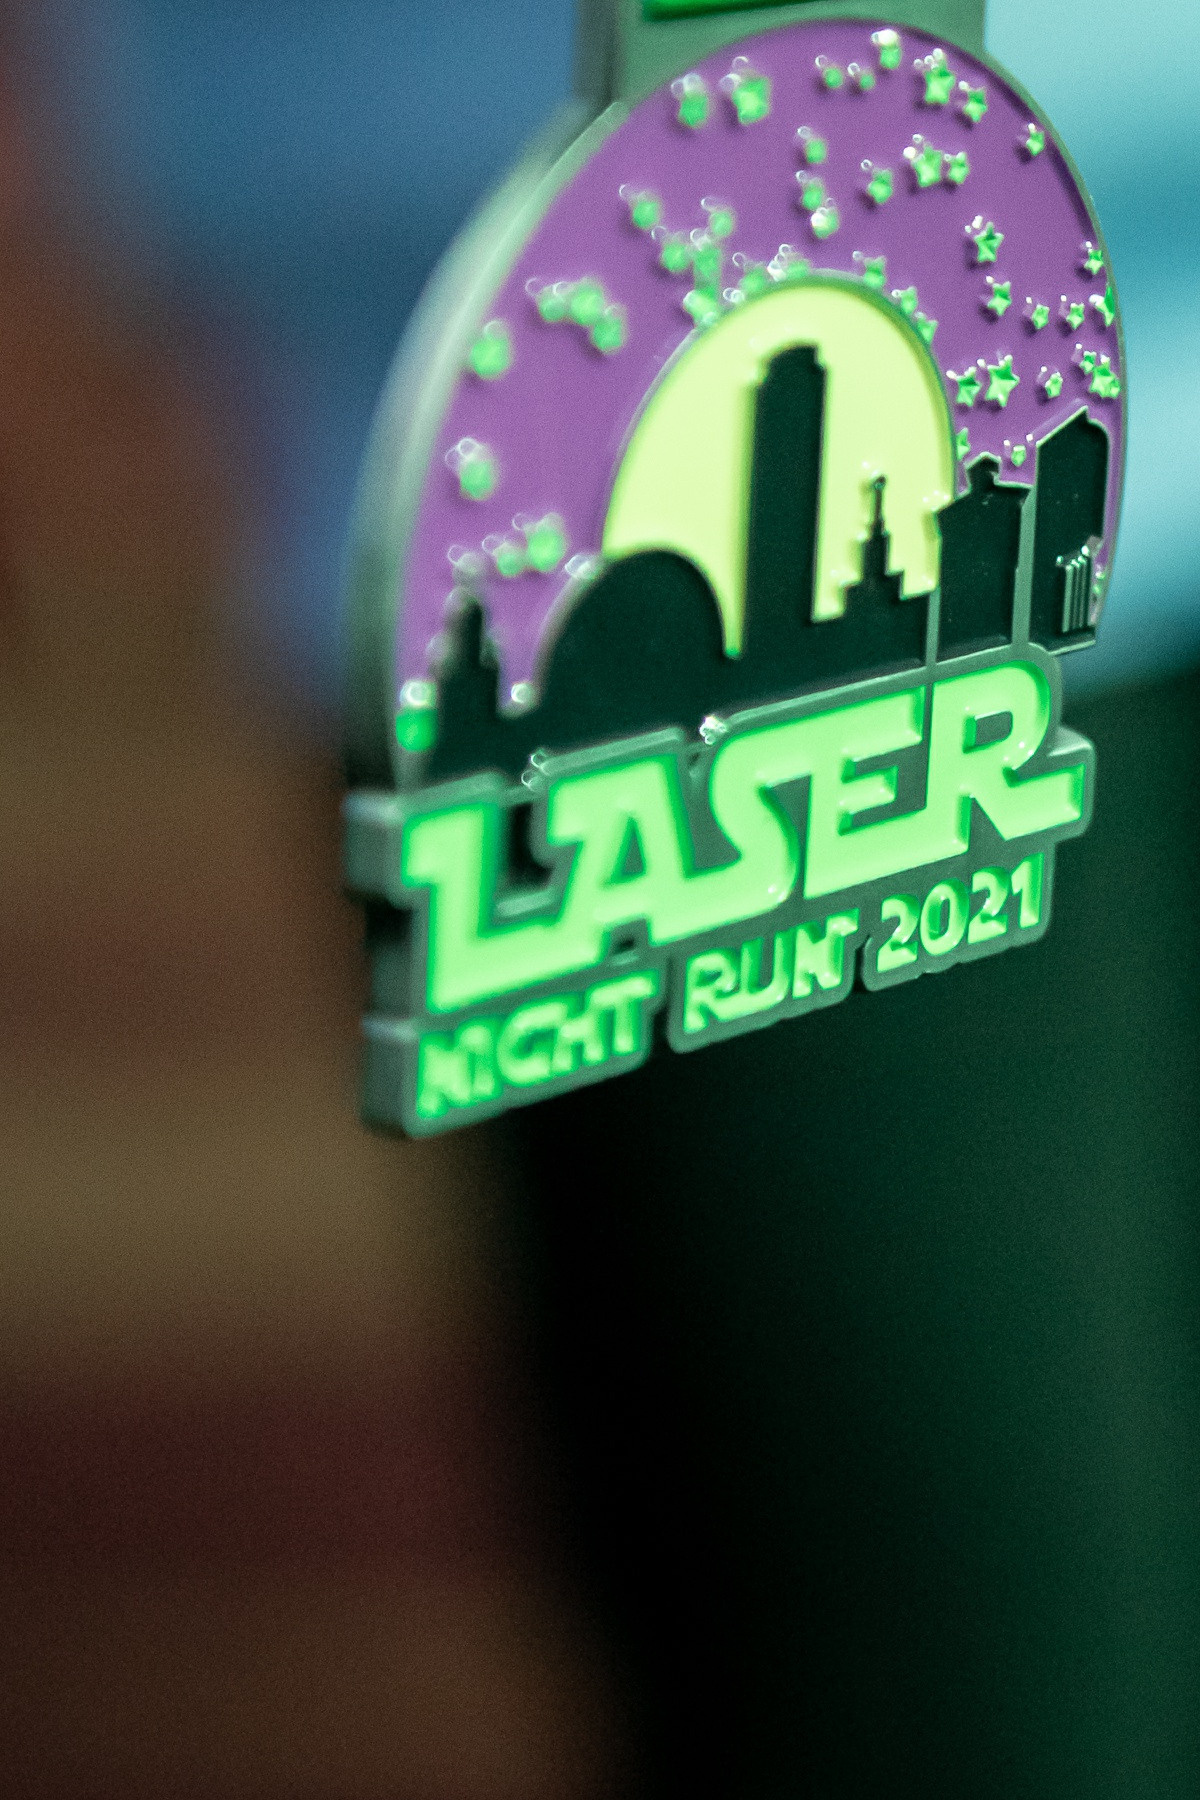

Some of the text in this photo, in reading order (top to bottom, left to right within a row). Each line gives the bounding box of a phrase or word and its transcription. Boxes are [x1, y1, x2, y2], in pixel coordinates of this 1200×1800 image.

[404, 659, 1085, 1013] LASER
[684, 907, 859, 1033] RUN
[876, 851, 1045, 973] 2021
